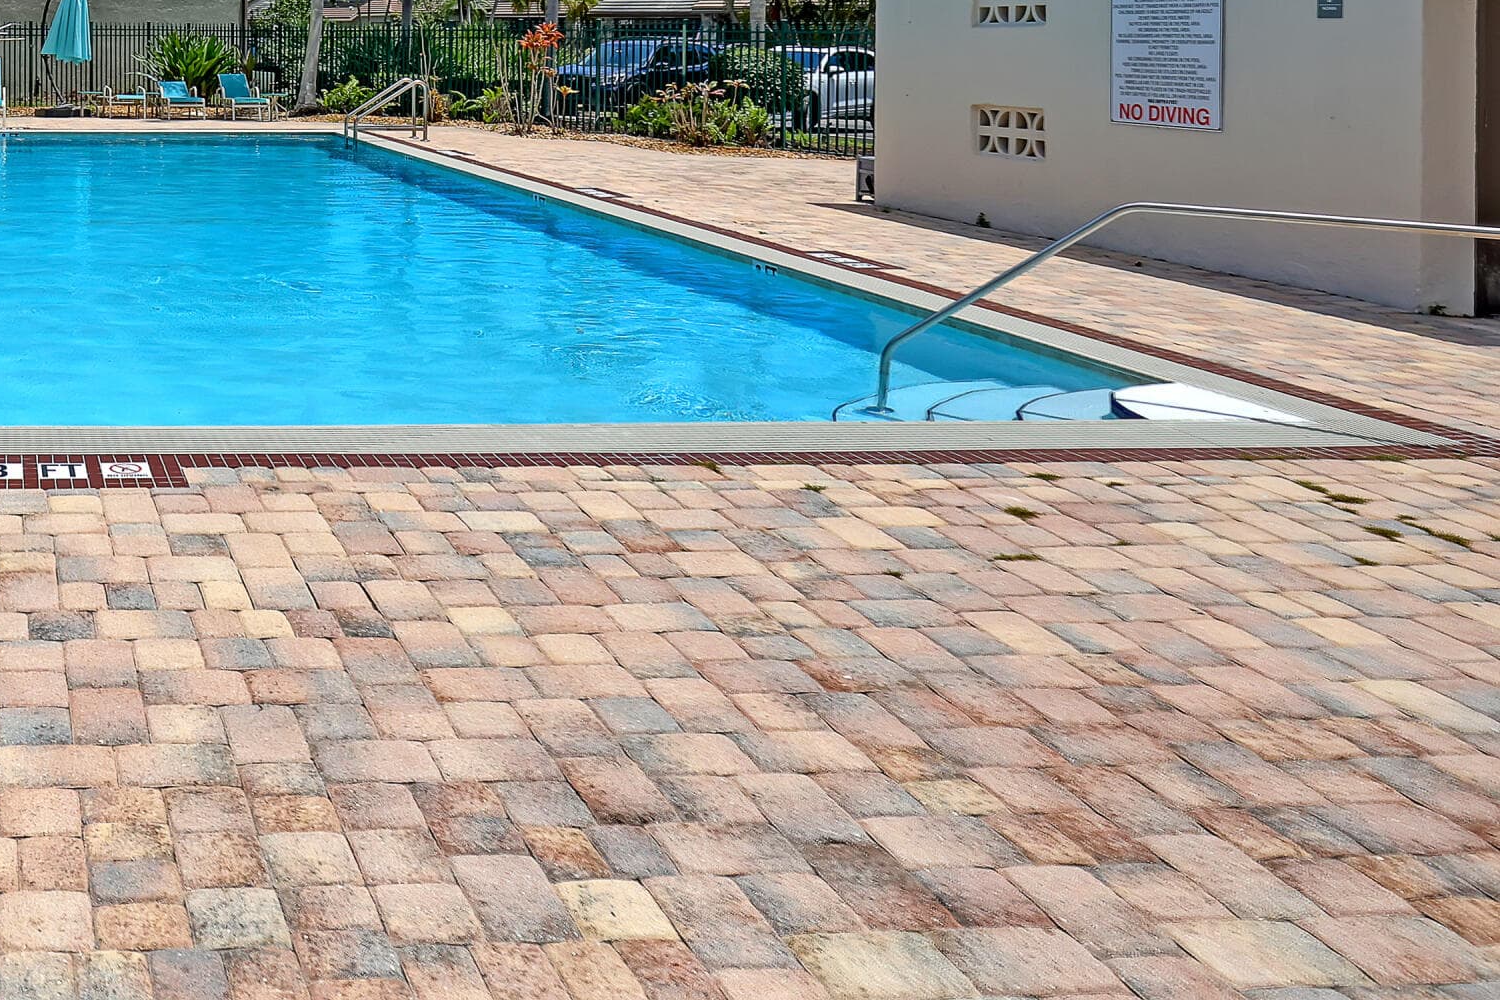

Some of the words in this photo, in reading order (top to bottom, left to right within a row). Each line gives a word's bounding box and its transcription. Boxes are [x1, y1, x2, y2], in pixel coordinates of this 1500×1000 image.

[1119, 103, 1143, 120] NO
[1148, 105, 1210, 125] DIVING
[41, 464, 82, 477] FT
